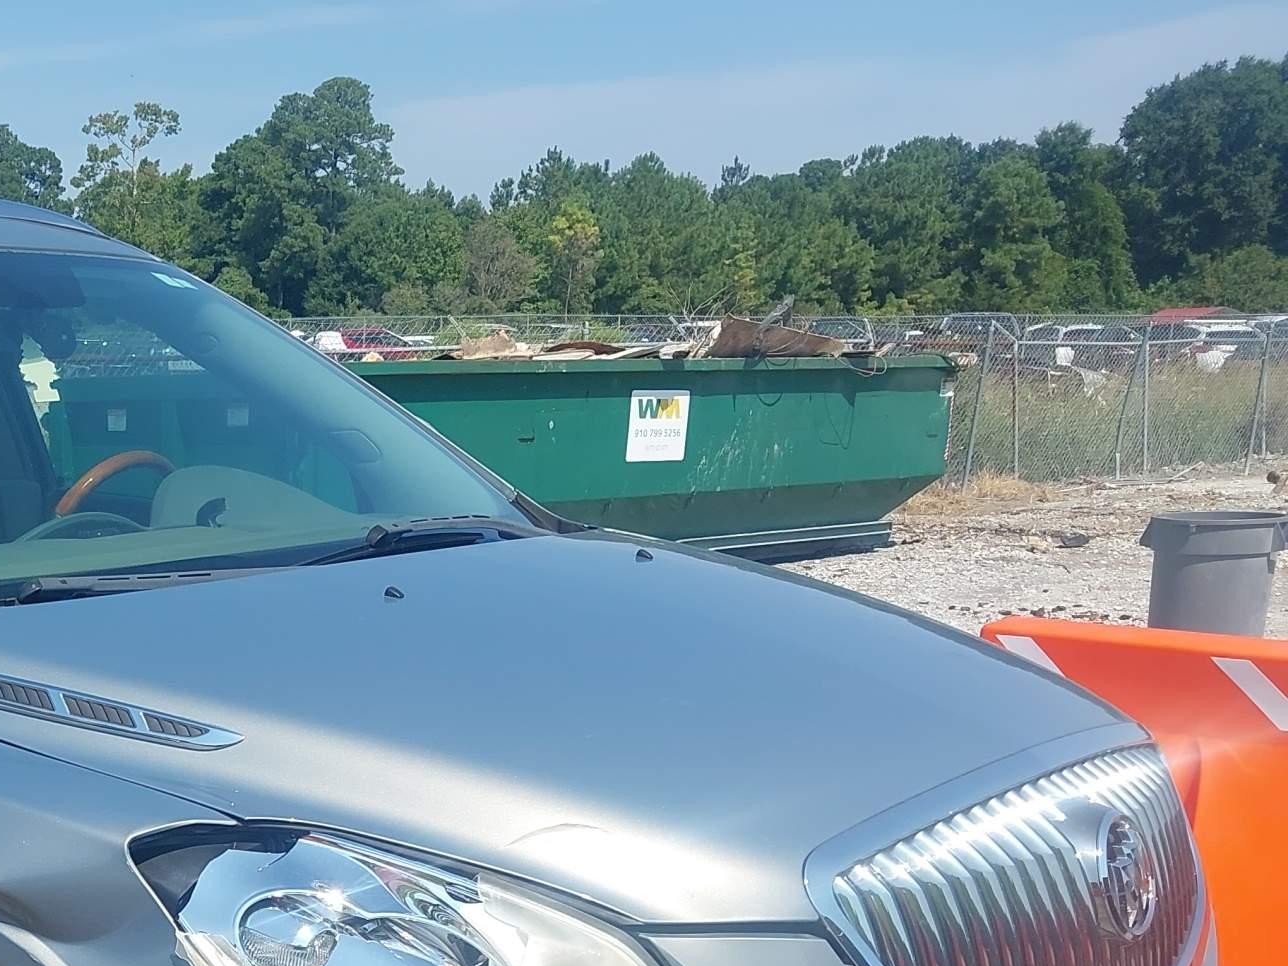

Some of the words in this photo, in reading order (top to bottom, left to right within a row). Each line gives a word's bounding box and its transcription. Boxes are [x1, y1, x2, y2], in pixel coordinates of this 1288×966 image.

[638, 398, 680, 419] WM
[634, 428, 648, 438] 910
[650, 428, 663, 438] 799
